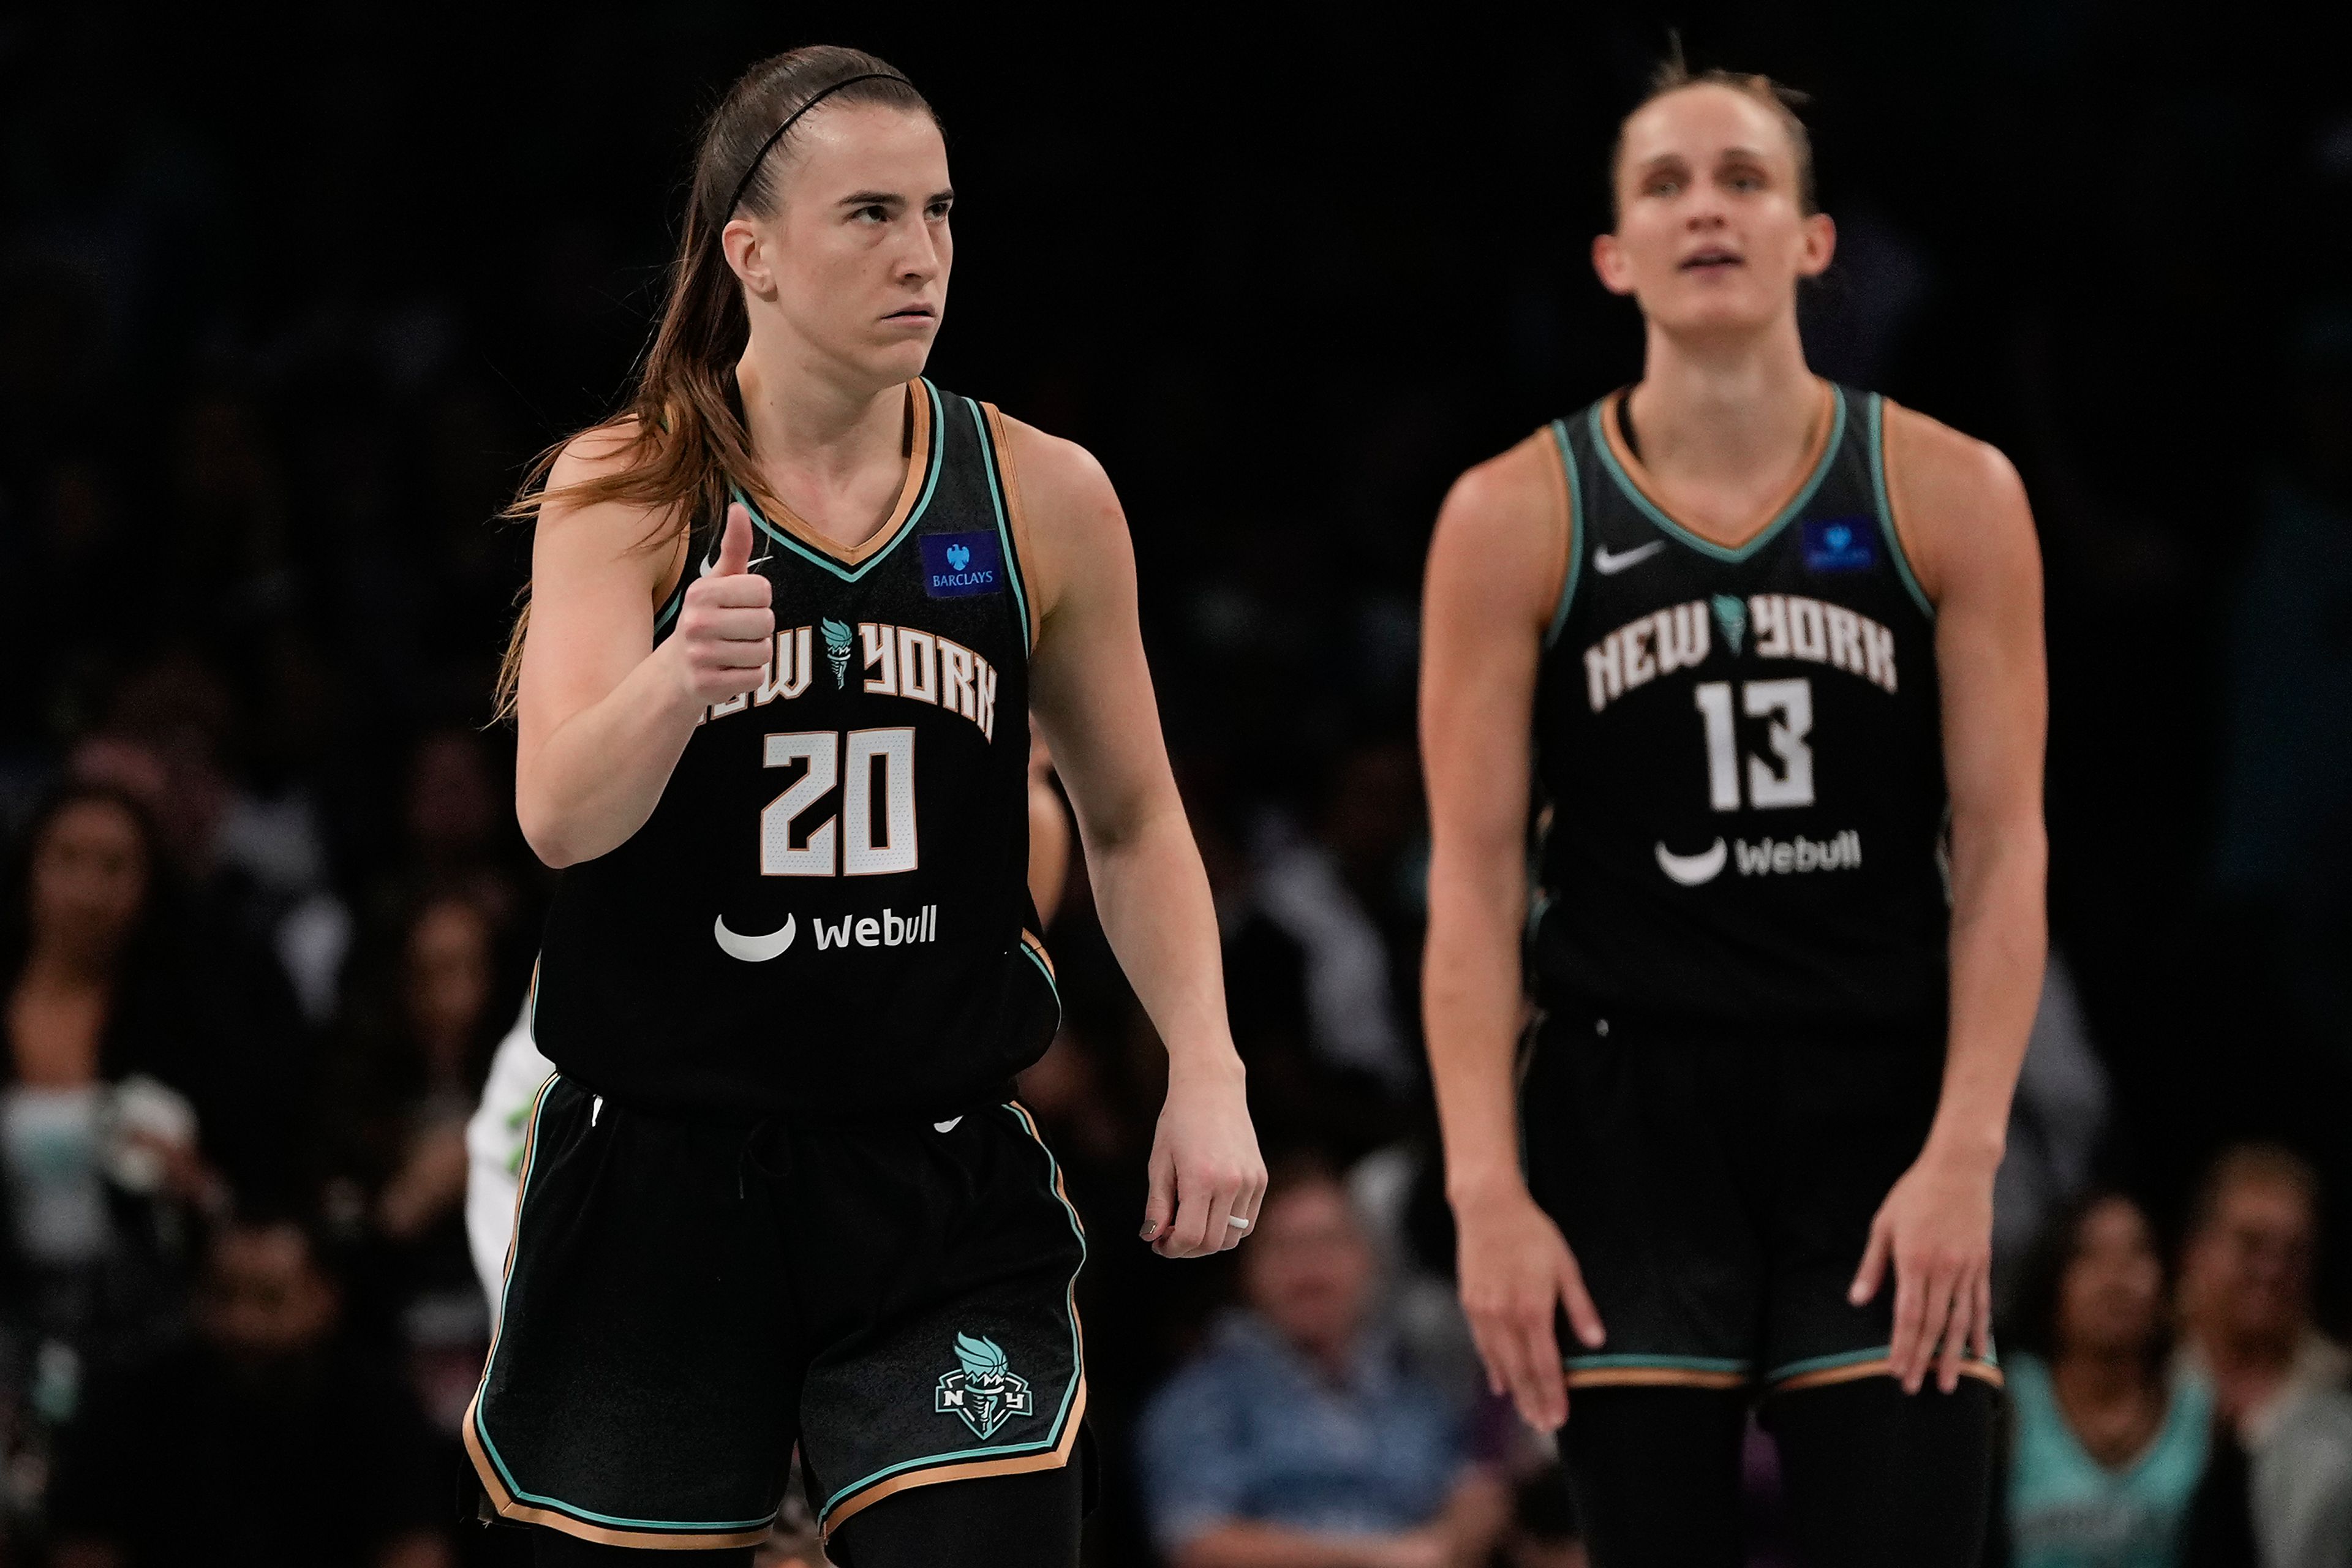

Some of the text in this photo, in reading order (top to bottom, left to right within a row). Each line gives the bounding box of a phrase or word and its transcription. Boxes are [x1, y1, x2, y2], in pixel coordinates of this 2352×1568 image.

[933, 571, 993, 587] BARCLAYS
[858, 622, 997, 745] YORK
[1584, 594, 1898, 712] NEW YORK
[760, 727, 918, 877] 20
[1694, 678, 1815, 811] 13
[1735, 830, 1861, 876] Webull
[813, 905, 937, 951] Webull
